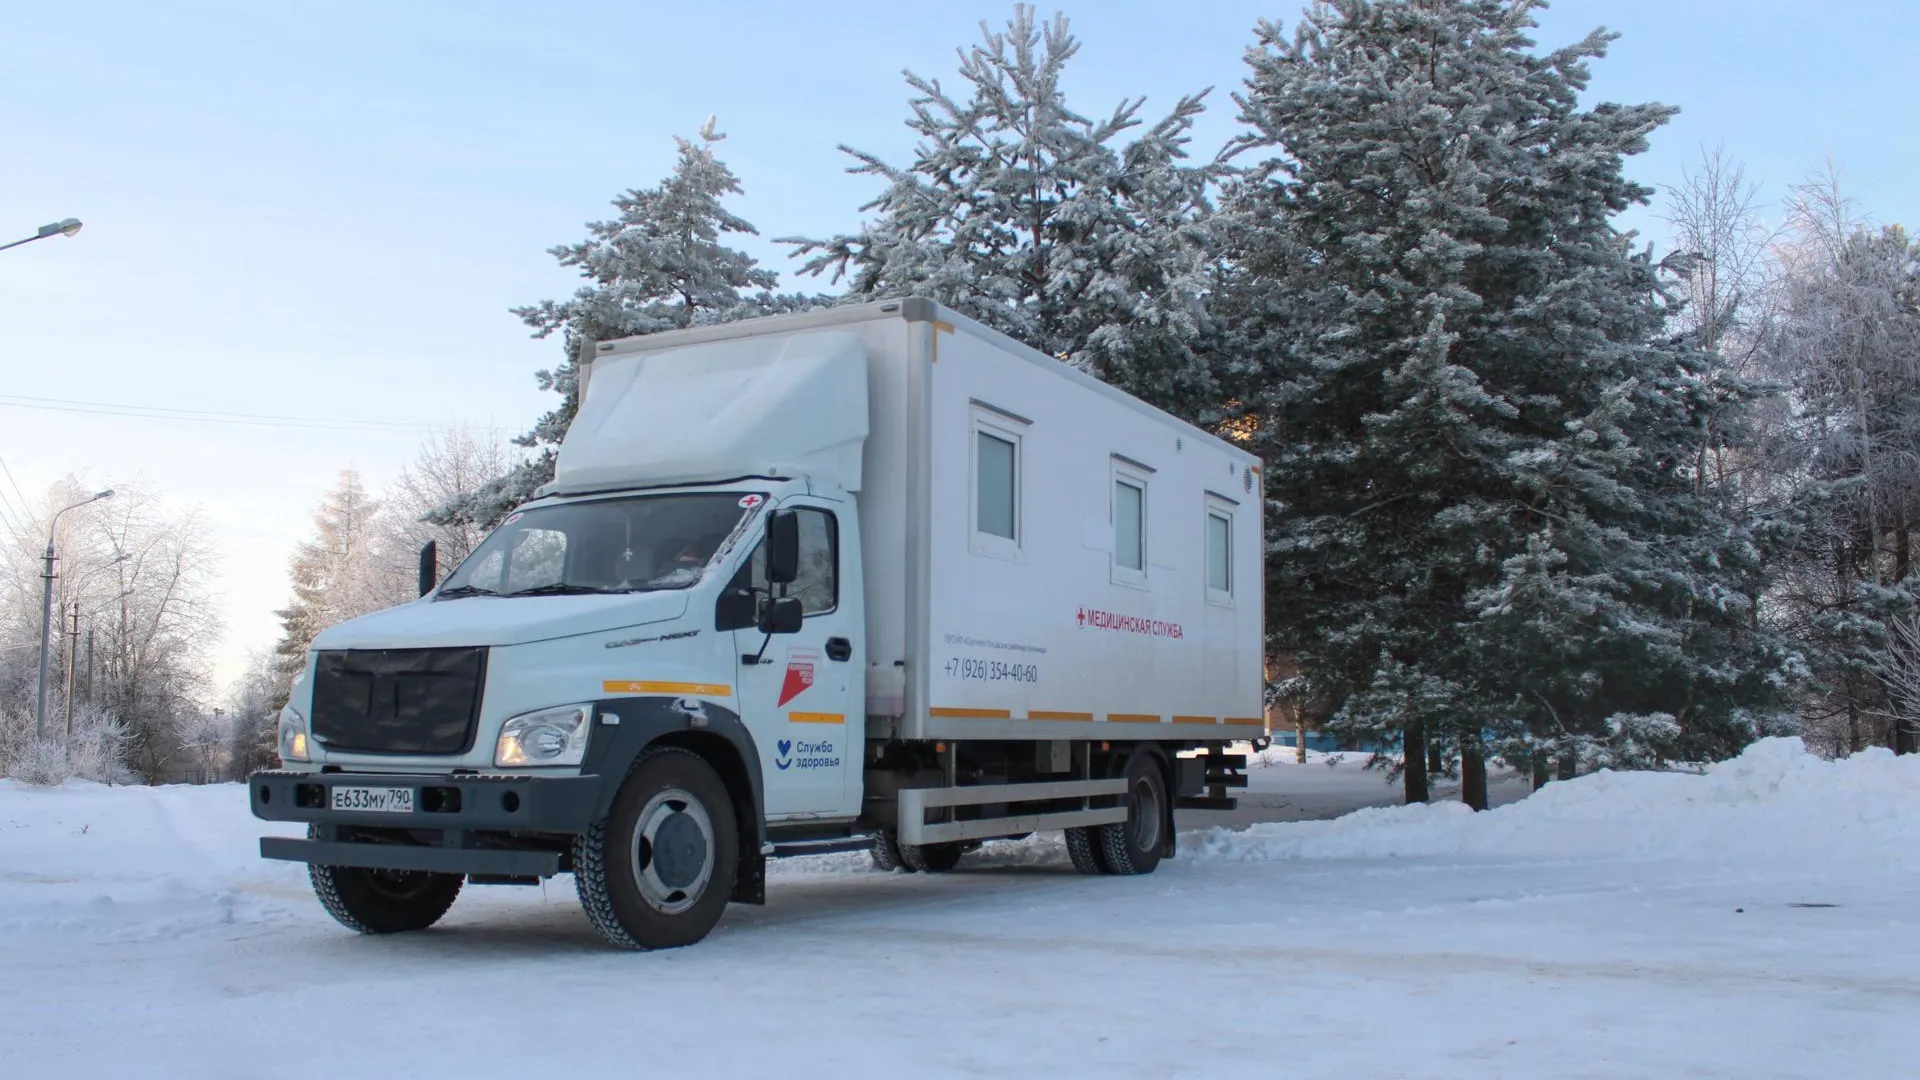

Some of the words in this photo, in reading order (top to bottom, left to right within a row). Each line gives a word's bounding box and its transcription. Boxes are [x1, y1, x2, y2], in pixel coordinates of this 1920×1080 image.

[1087, 609, 1151, 634] МЕДИЦИНСКАЯ
[1152, 620, 1183, 640] СЛУЖБА
[944, 657, 959, 677] +7
[962, 658, 988, 682] (926)
[989, 661, 1037, 682] 354-40-60
[796, 740, 833, 756] Служба
[796, 758, 840, 770] здоровья
[335, 789, 386, 809] Е633МУ
[389, 789, 410, 804] 790
